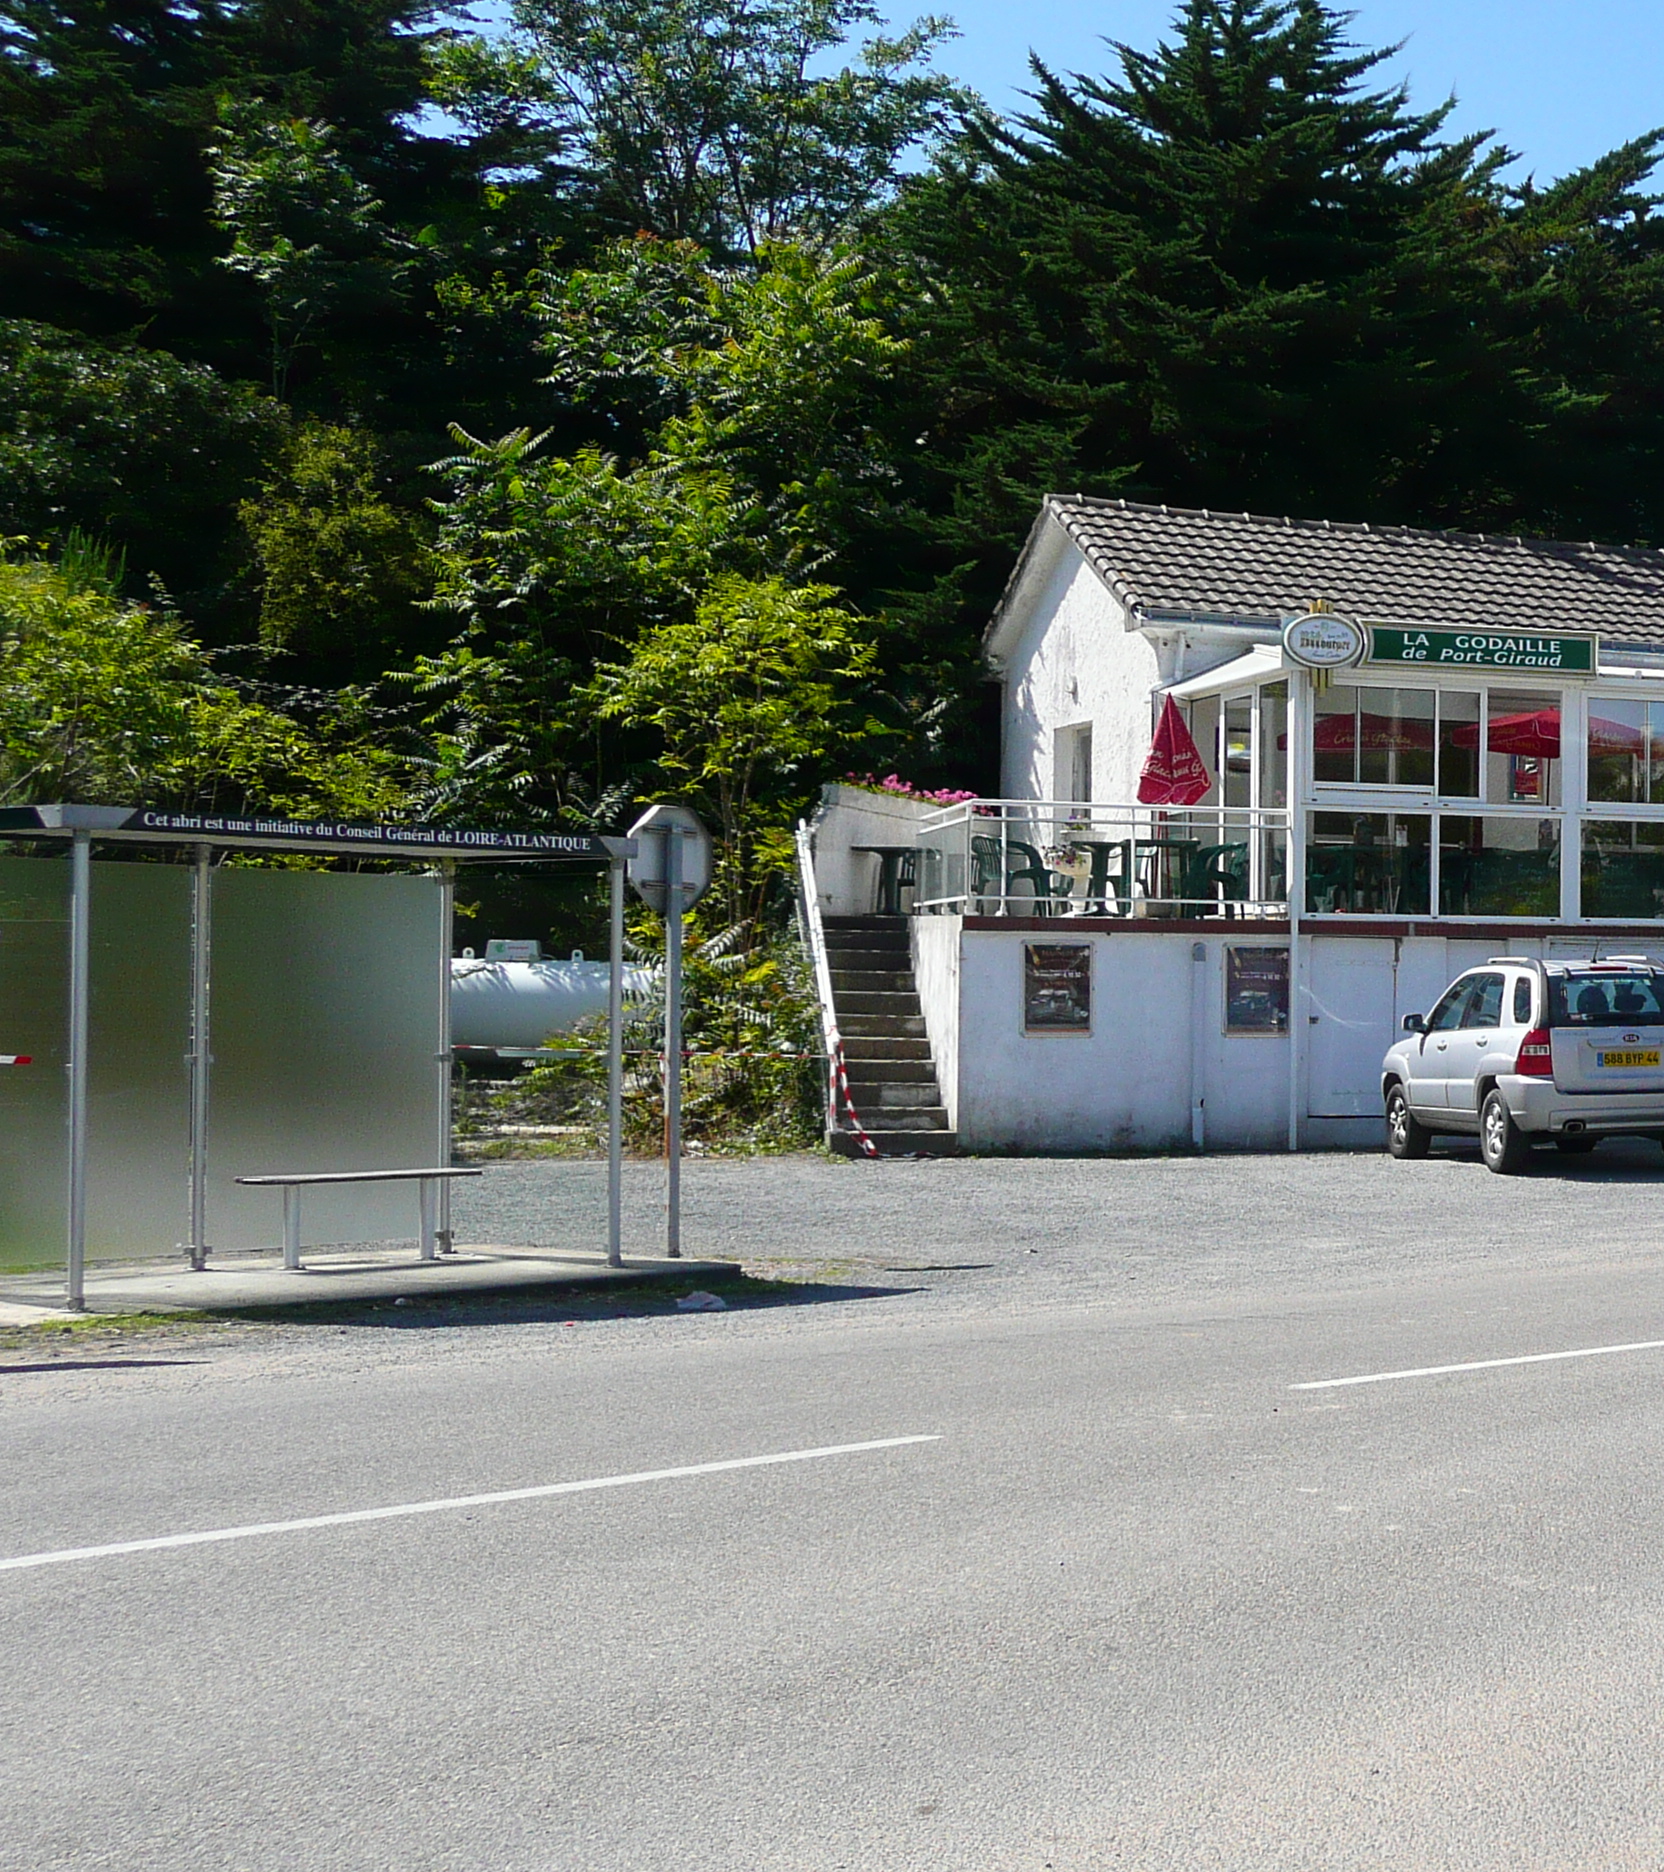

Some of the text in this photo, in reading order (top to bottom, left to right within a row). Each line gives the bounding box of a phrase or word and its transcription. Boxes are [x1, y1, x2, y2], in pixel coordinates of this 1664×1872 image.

[1403, 633, 1561, 654] LA GODAILLE
[1402, 647, 1562, 667] de Port-Giraud
[143, 811, 591, 851] Cet abri est une initiative du Conseil Général de LOIRE-ATLANTIQUE
[1604, 1052, 1659, 1065] 588 BYP 44
